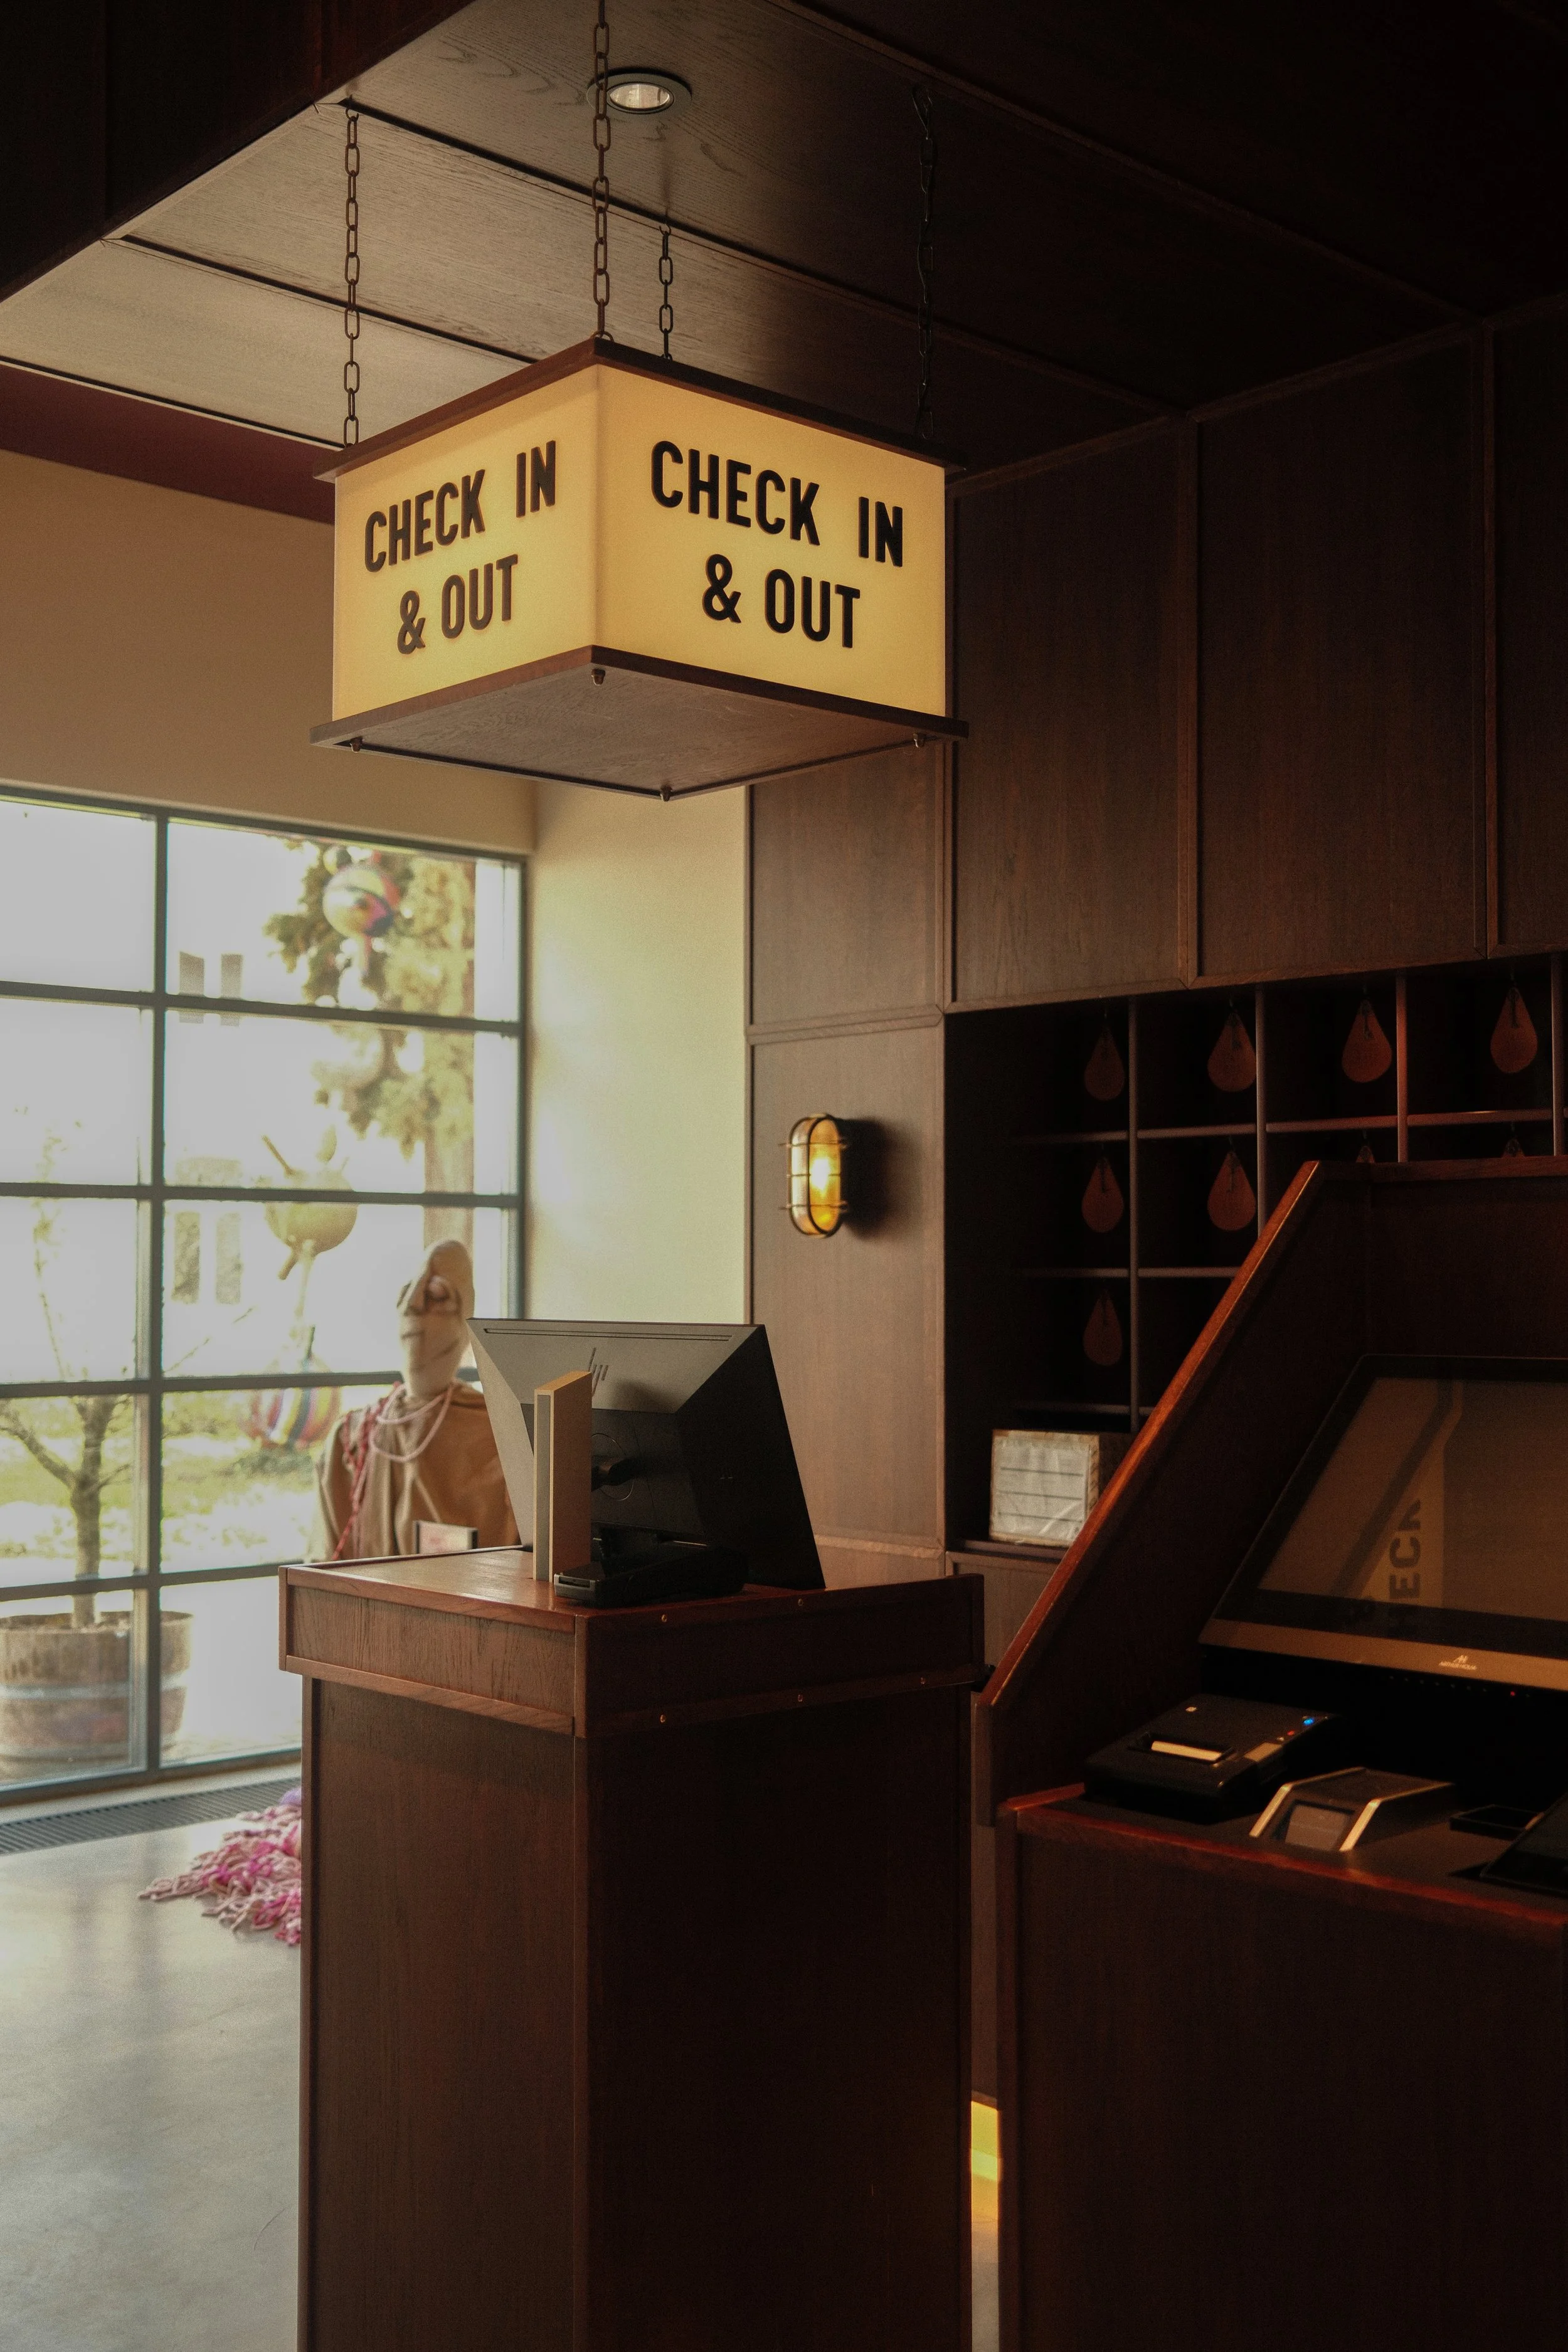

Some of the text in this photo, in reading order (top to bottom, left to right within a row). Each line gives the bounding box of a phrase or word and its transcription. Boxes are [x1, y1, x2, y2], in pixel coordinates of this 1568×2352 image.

[364, 440, 556, 573] CHECK IN
[651, 440, 903, 568] CHECK IN
[396, 553, 519, 654] & OUT
[702, 553, 861, 649] & OUT
